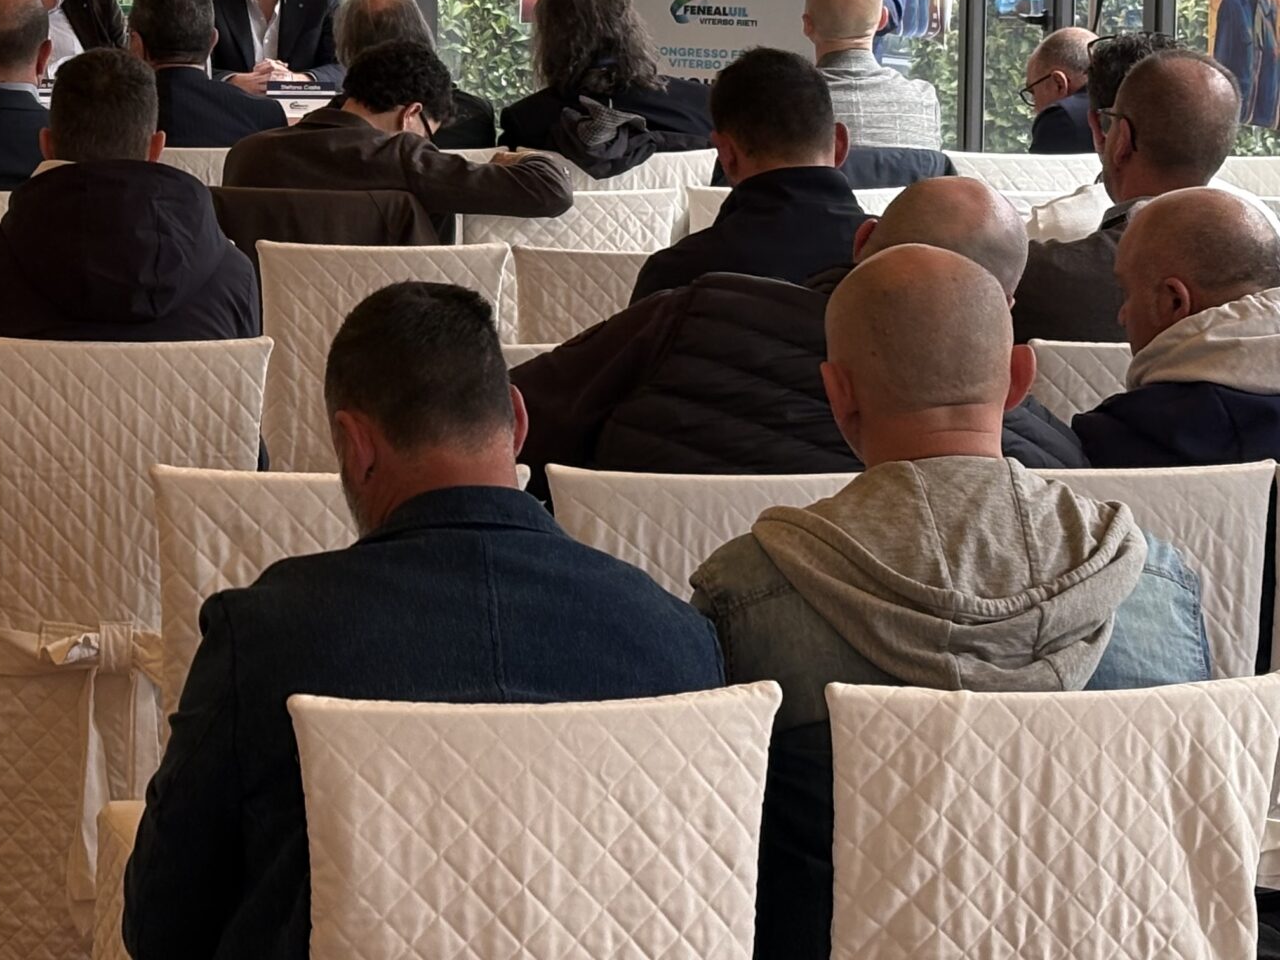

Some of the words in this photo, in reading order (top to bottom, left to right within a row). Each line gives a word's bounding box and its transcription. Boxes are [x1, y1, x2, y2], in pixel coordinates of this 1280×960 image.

[683, 5, 748, 17] FENEALUIL
[699, 18, 734, 26] VITERBO
[736, 19, 758, 27] RIETI
[657, 46, 728, 59] ONGRESSO
[669, 58, 722, 69] VITERBO
